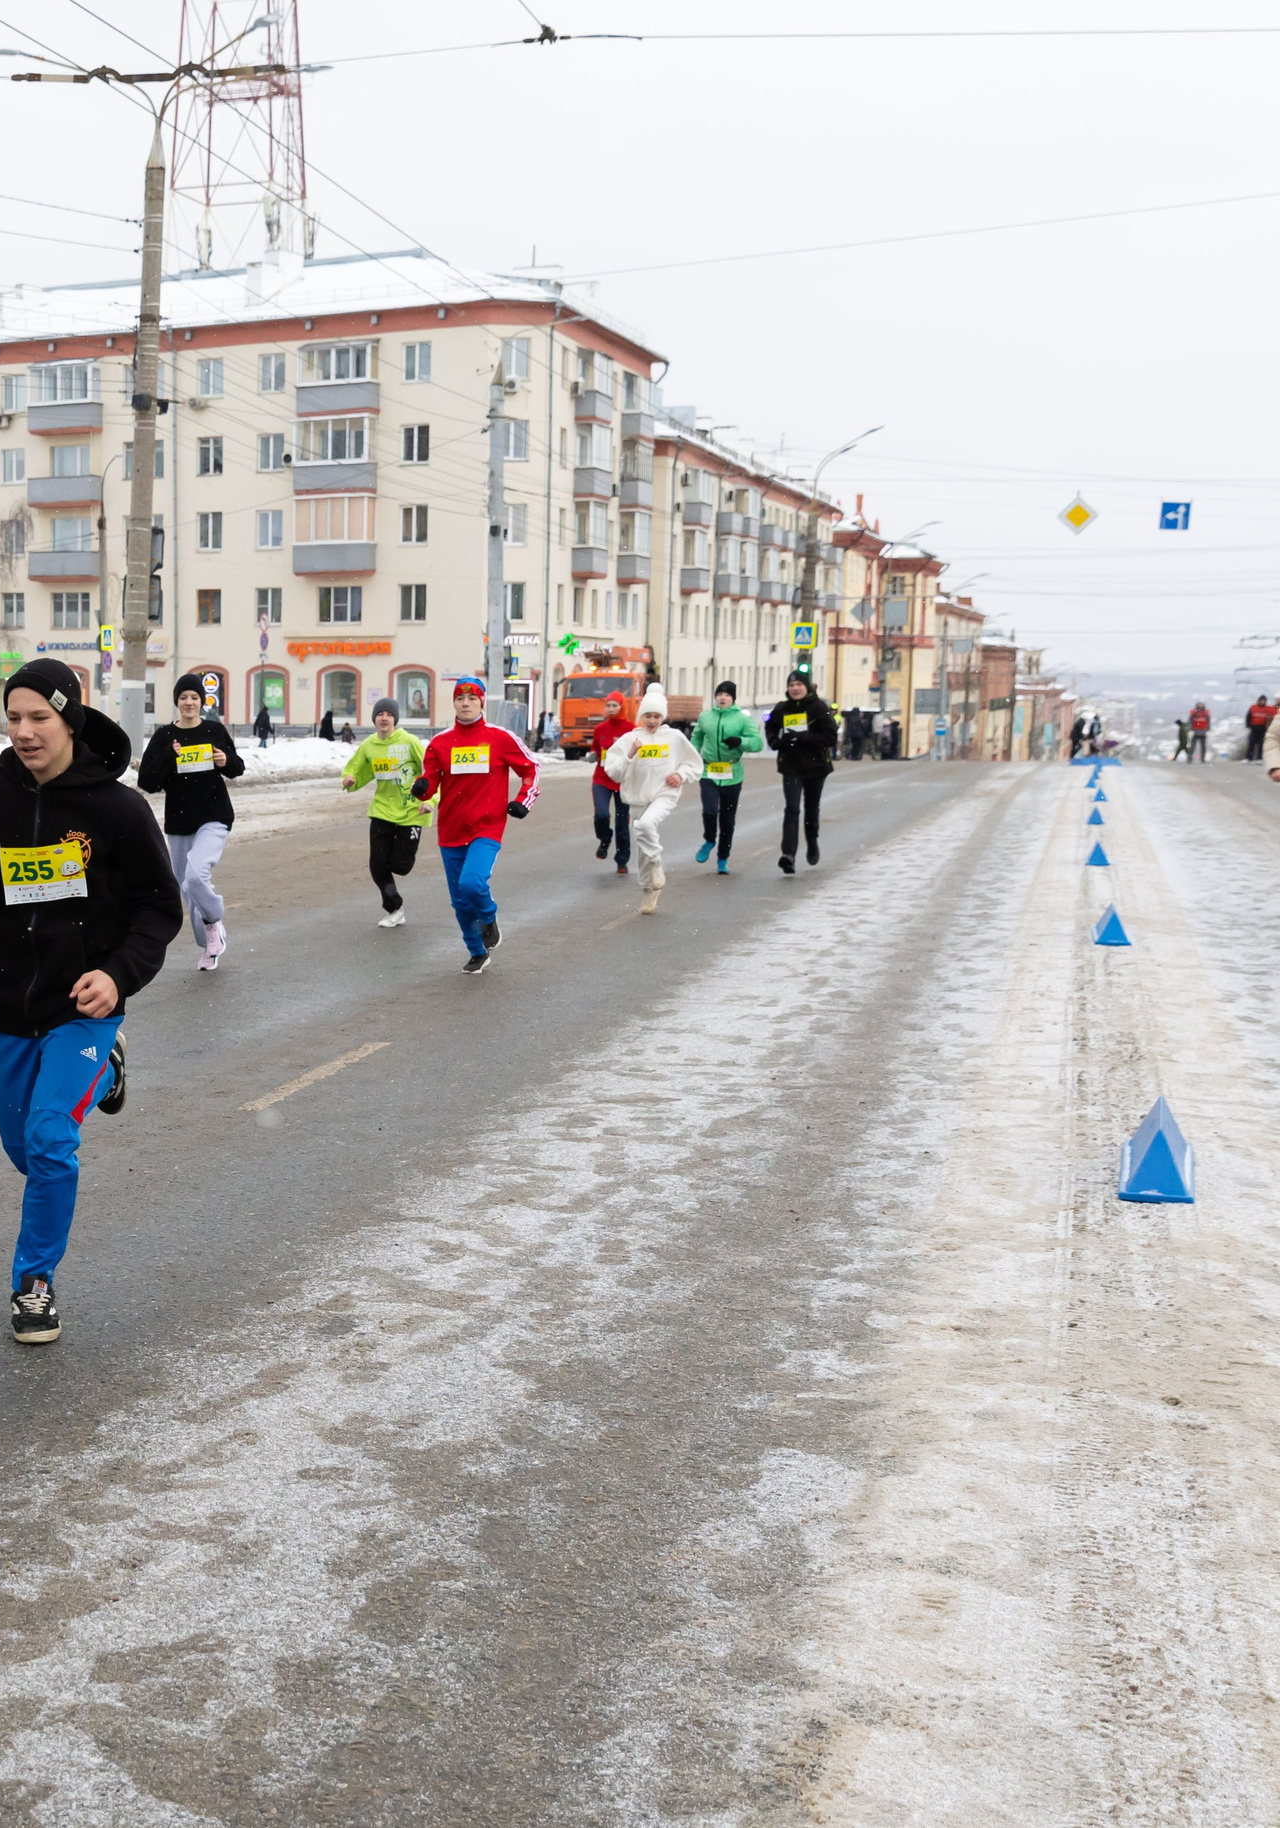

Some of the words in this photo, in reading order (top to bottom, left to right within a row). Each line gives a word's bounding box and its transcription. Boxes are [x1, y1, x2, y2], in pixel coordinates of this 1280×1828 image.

[504, 635, 540, 646] ПТЕКА
[287, 642, 391, 663] ортопедия
[180, 752, 200, 763] 257
[455, 753, 476, 763] 263
[641, 749, 658, 758] 247
[374, 763, 389, 772] 248
[66, 831, 87, 839] HOOK
[8, 860, 54, 882] 255
[80, 1050, 98, 1062] adidas
